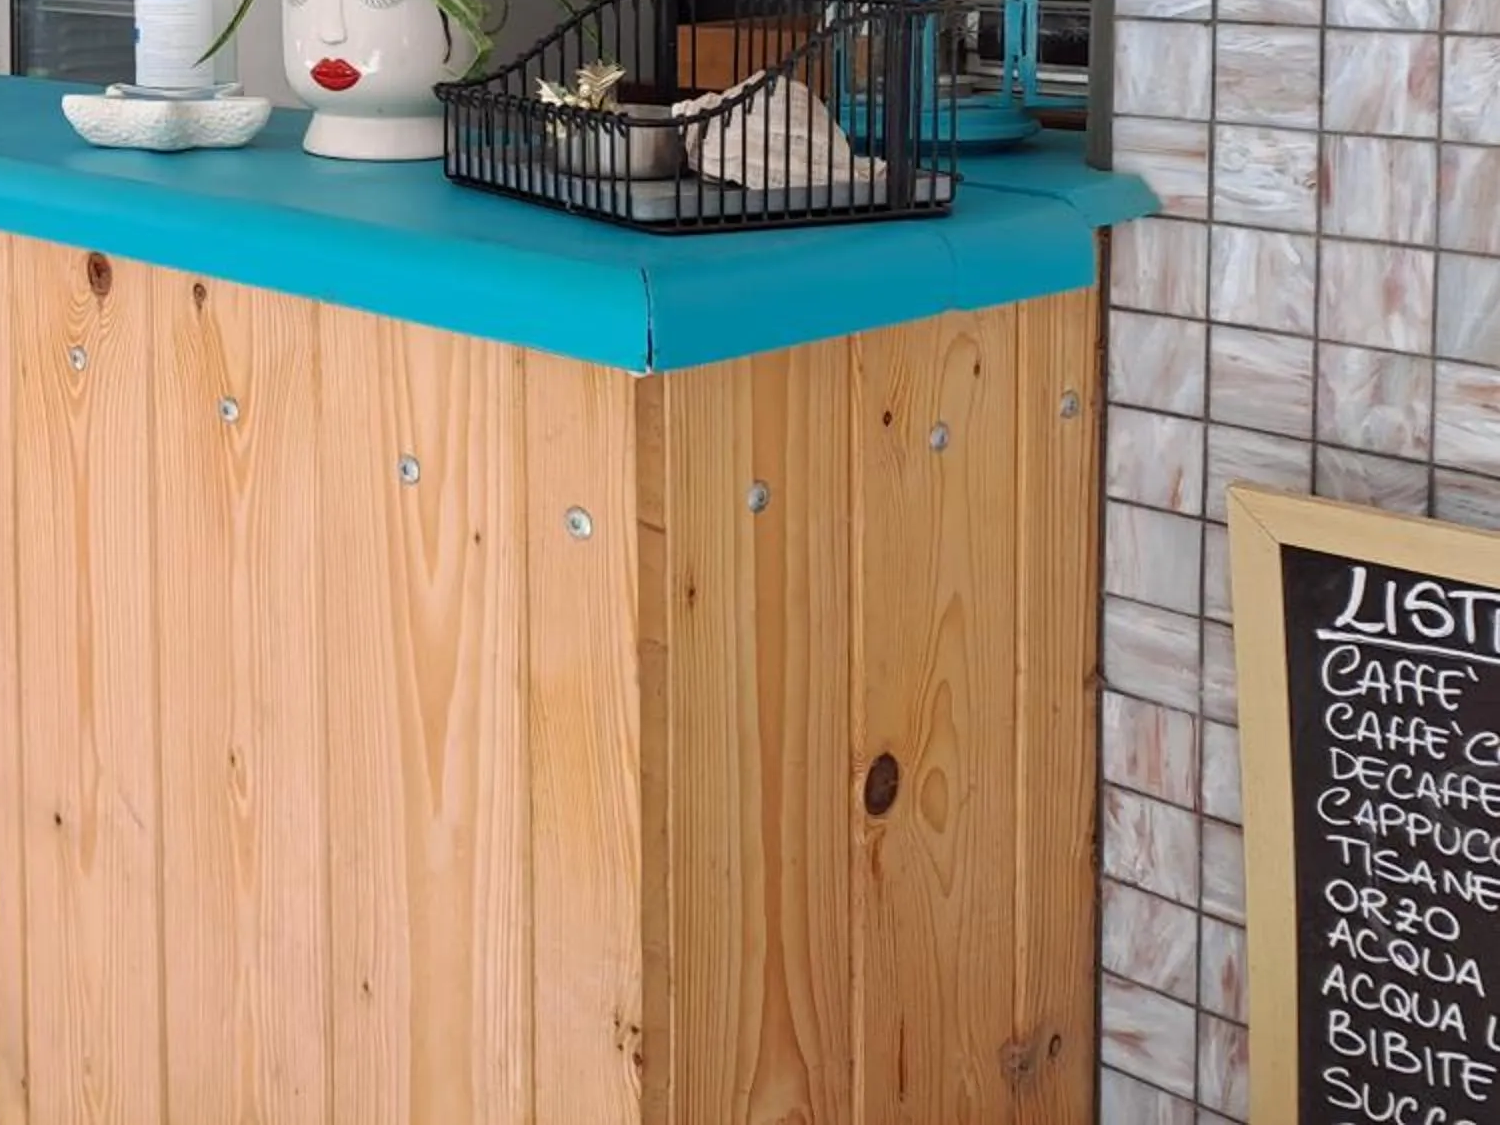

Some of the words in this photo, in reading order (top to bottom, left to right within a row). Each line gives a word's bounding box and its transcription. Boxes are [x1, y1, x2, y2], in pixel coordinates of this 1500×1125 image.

[1325, 879, 1460, 941] ORZO
[1326, 834, 1500, 911] TISANE
[1327, 918, 1485, 998] ACQUA
[1321, 963, 1467, 1042] ACQUA
[1328, 1008, 1497, 1101] BIBITE
